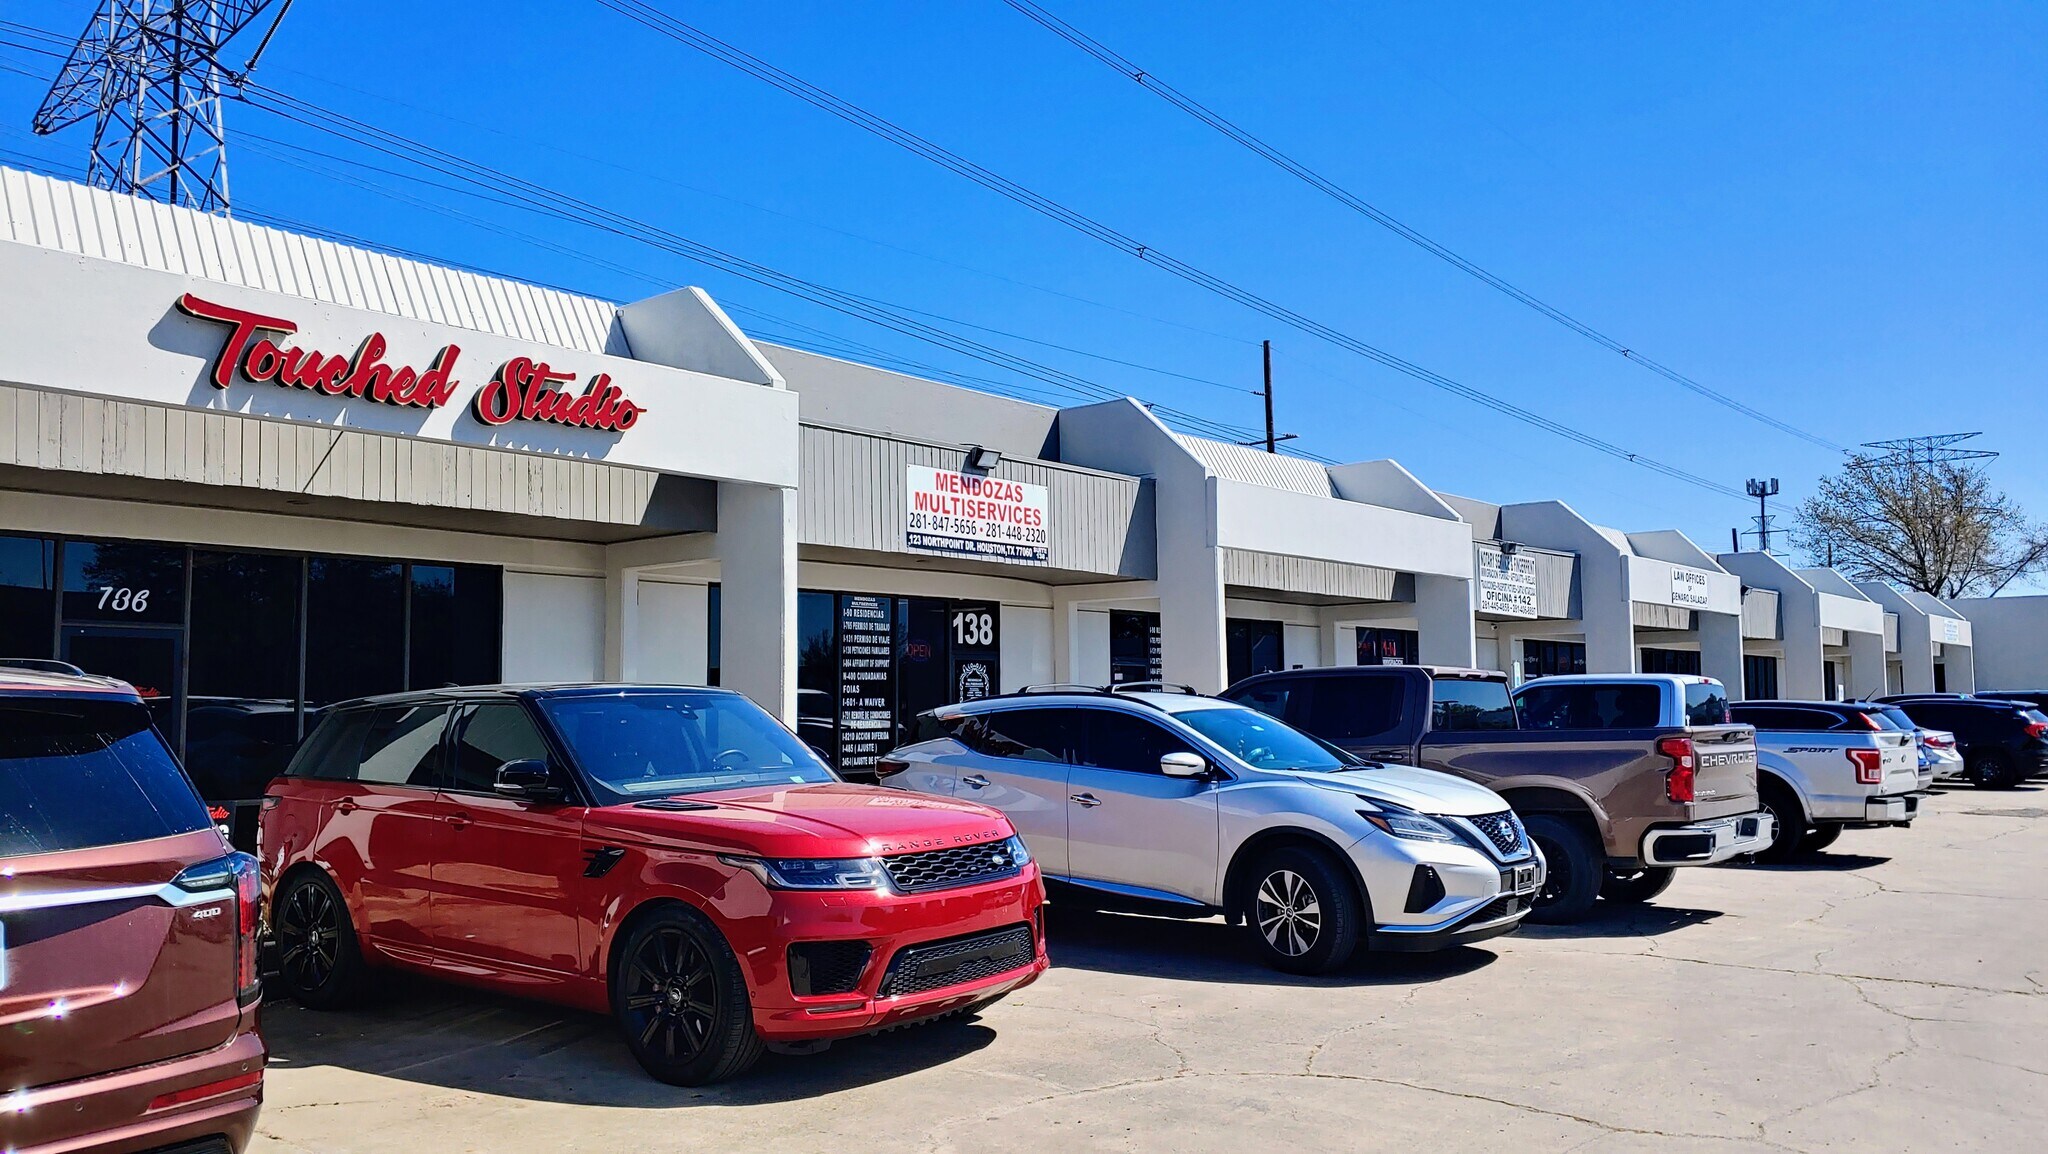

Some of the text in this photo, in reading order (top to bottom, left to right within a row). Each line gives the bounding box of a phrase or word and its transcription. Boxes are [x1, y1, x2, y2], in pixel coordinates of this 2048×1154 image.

[177, 292, 646, 432] Touched Studio
[935, 472, 1023, 503] MENDOZAS
[914, 491, 1042, 527] MULTISERVICES
[909, 512, 1046, 544] 281-847-5656 281-448-2320
[922, 535, 964, 550] NORTHPOINT
[965, 540, 976, 552] DR.
[1016, 547, 1033, 557] 77060
[1673, 570, 1705, 585] LAW OFFICES
[98, 586, 150, 612] 736
[1486, 590, 1512, 603] OFICINA
[853, 608, 884, 618] RESIDENCIAS
[853, 621, 868, 630] PERMISO
[869, 622, 874, 631] DE
[874, 622, 890, 631] TRABAJO
[952, 612, 993, 645] 138
[853, 634, 871, 643] PERMISO
[872, 635, 878, 644] DE
[878, 635, 890, 644] VIAJE
[906, 643, 931, 657] OPEN
[869, 659, 874, 668] OF
[875, 659, 890, 668] SUPPORT
[843, 685, 860, 694] FOIAS
[858, 698, 863, 706] A
[864, 698, 885, 707] WAIVER
[855, 732, 870, 741] ACCION
[857, 743, 874, 752] AJUSTE
[868, 756, 873, 765] DE
[882, 829, 999, 851] RANGE ROVER
[192, 907, 221, 919] 400
